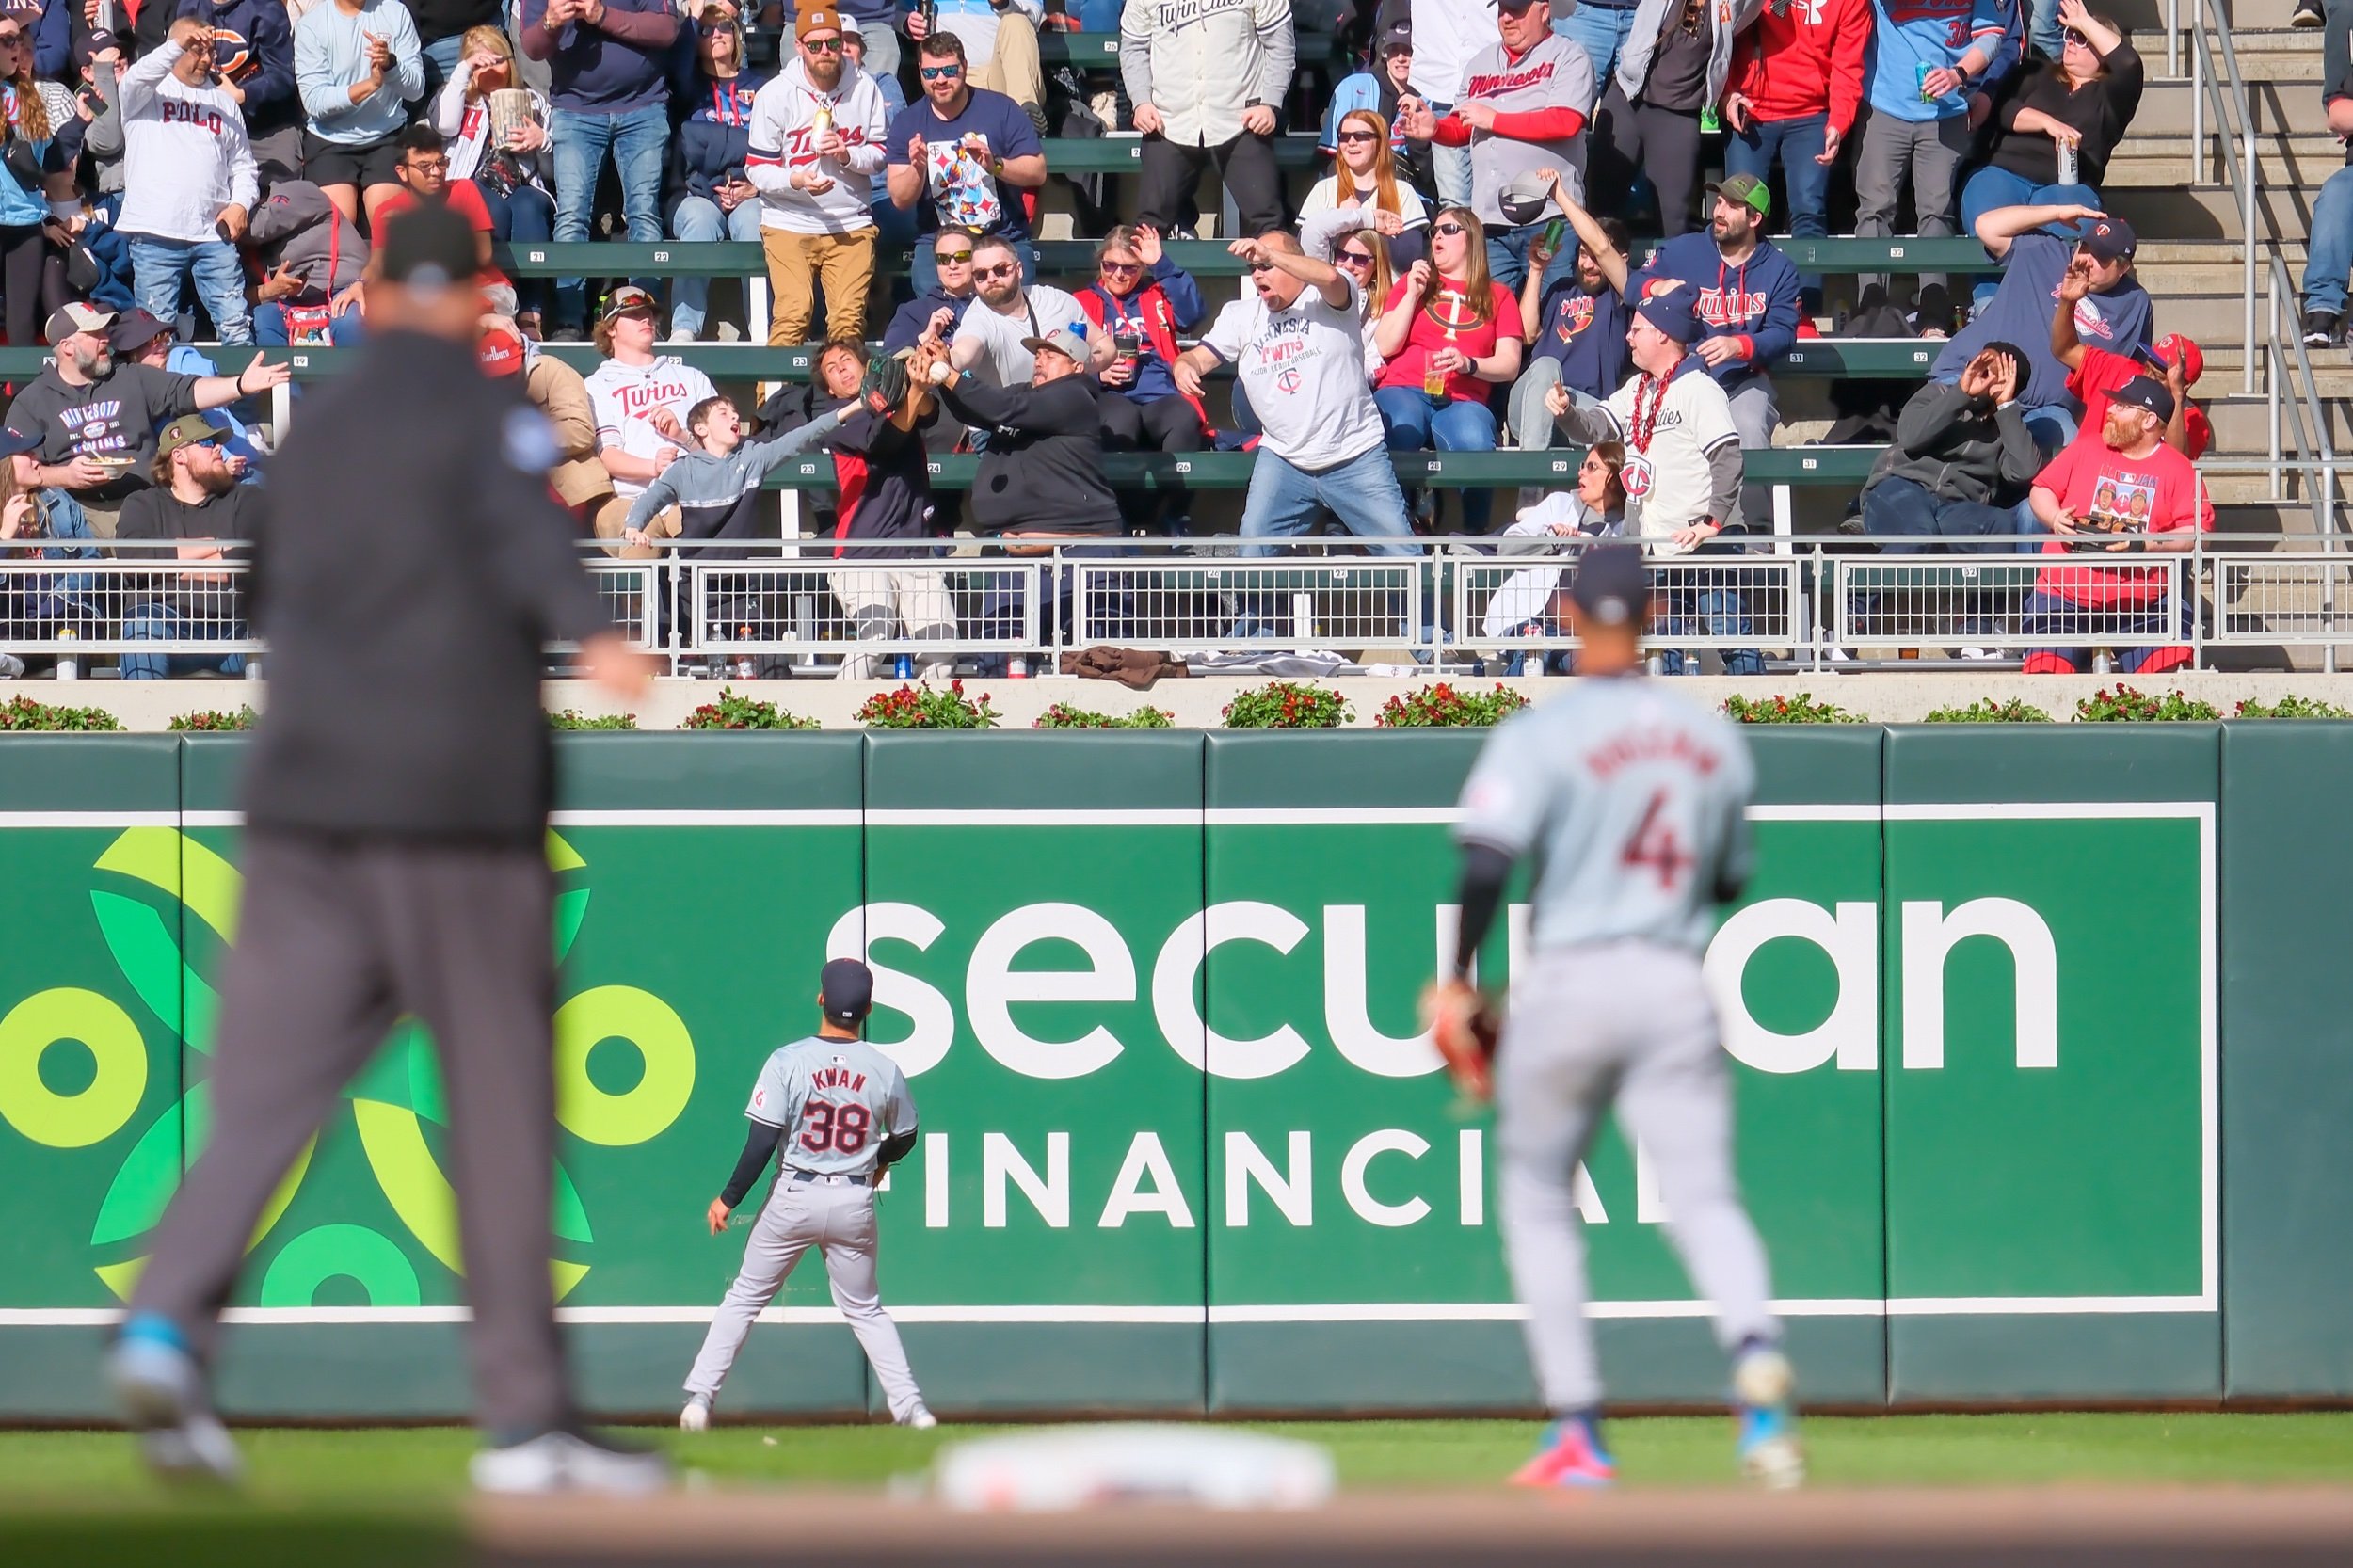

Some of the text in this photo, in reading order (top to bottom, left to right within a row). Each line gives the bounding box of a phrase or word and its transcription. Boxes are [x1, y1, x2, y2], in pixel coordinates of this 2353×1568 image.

[1105, 42, 1117, 51] 26
[163, 101, 222, 136] POLO
[786, 125, 865, 154] Tns
[656, 252, 668, 261] 22
[1892, 248, 1903, 257] 32
[296, 357, 307, 366] 19
[1791, 354, 1803, 362] 31
[1914, 353, 1927, 361] 32
[793, 358, 807, 366] 23
[612, 380, 688, 418] Twins
[58, 400, 121, 429] MINESOTA
[928, 464, 940, 472] 24
[1176, 463, 1191, 472] 26
[1429, 462, 1441, 471] 28
[1554, 462, 1567, 471] 29
[1803, 459, 1817, 468] 31
[801, 464, 814, 473] 23
[1622, 786, 1698, 891] 4
[811, 1067, 867, 1093] KWAN
[799, 1099, 871, 1156] 38
